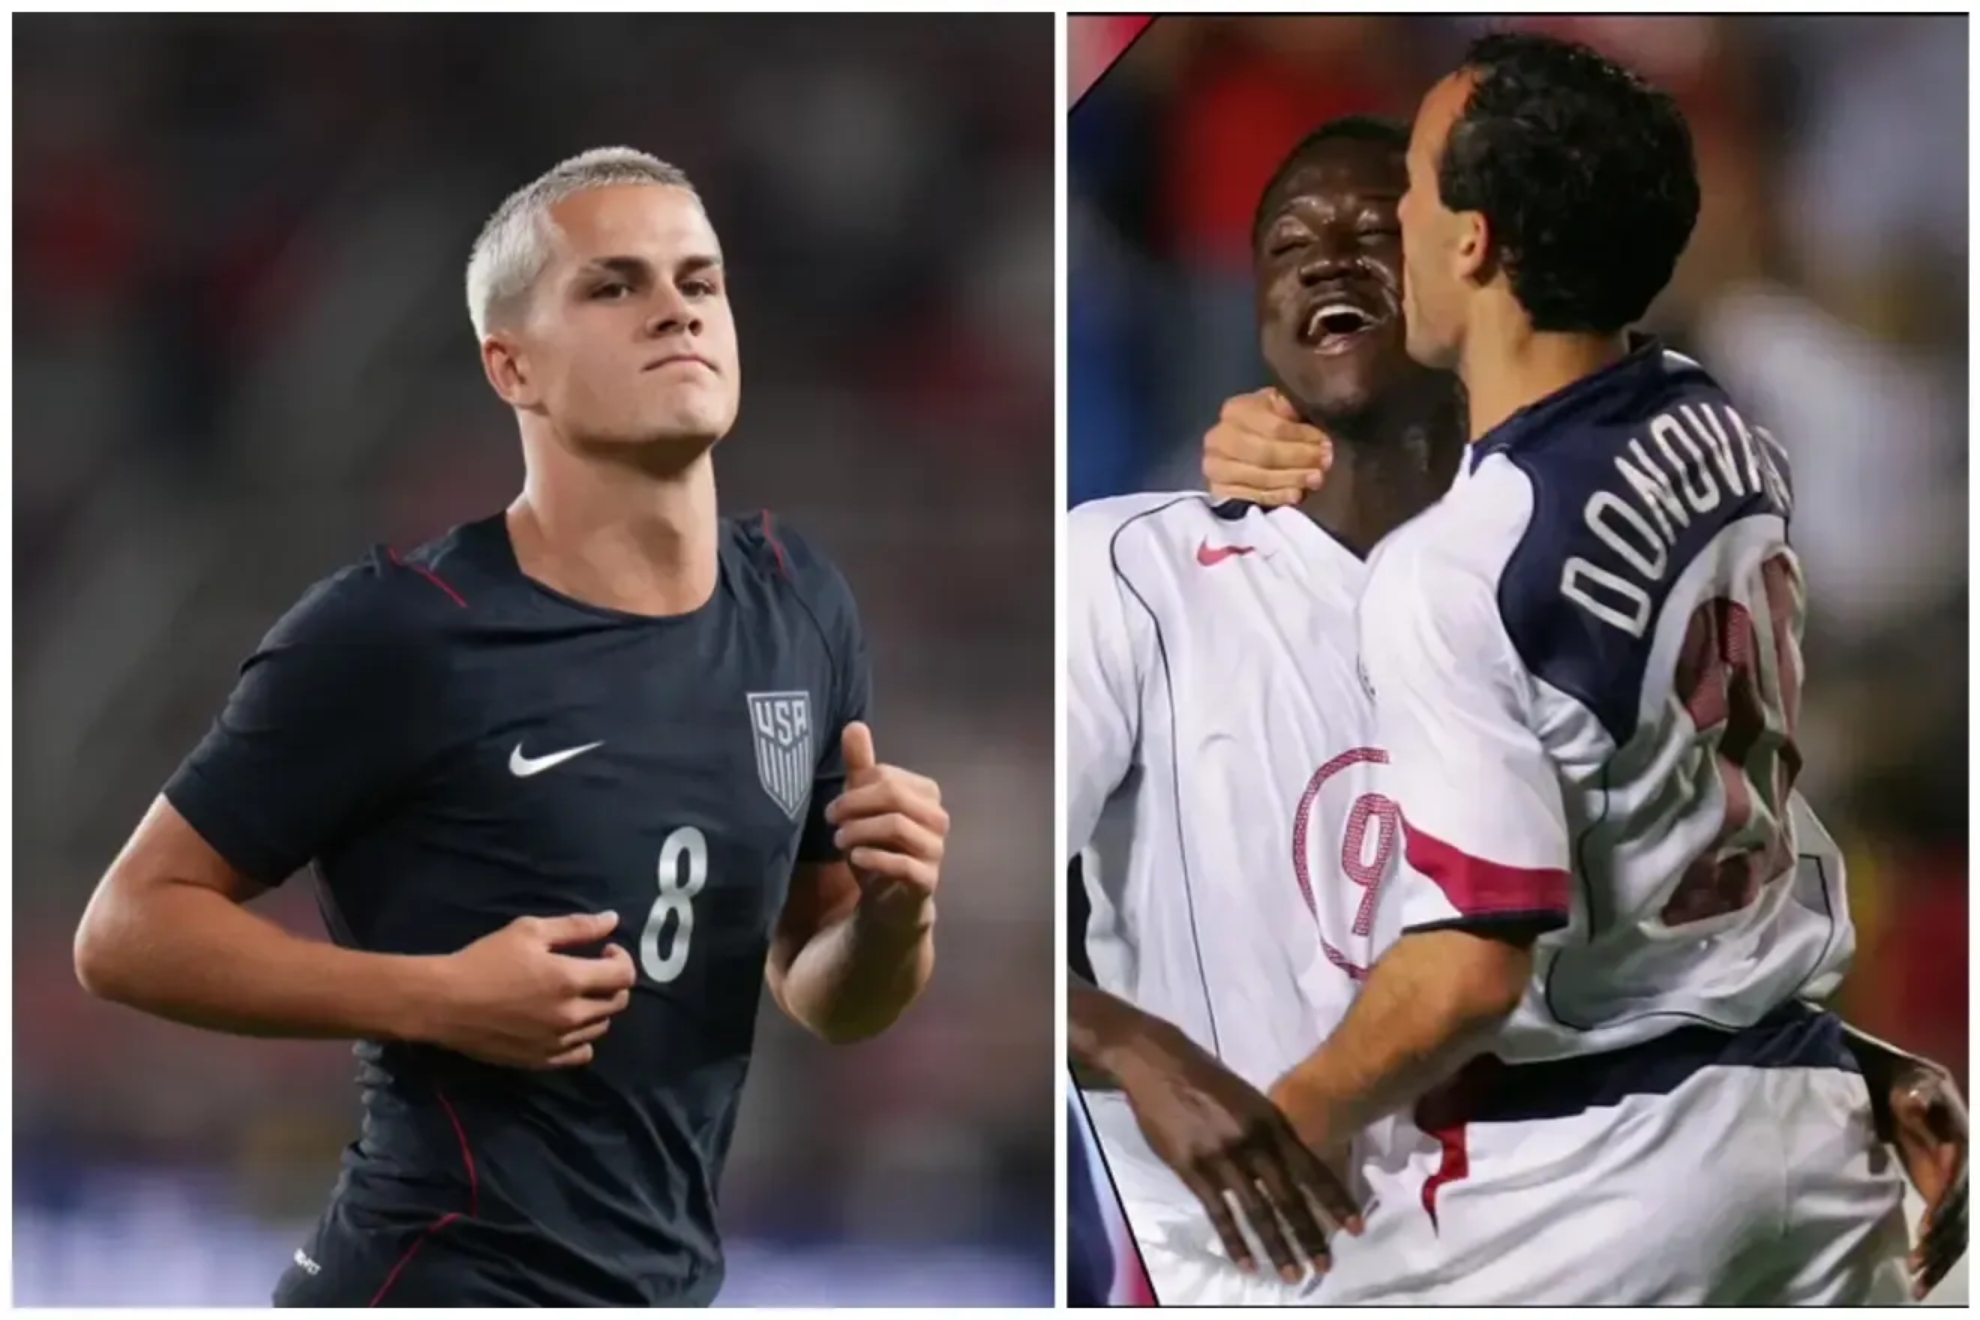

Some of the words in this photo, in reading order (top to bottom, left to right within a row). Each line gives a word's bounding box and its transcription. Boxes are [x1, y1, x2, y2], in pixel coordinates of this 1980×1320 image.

[755, 700, 808, 746] USA
[640, 826, 708, 983] 8
[1342, 793, 1398, 936] 9
